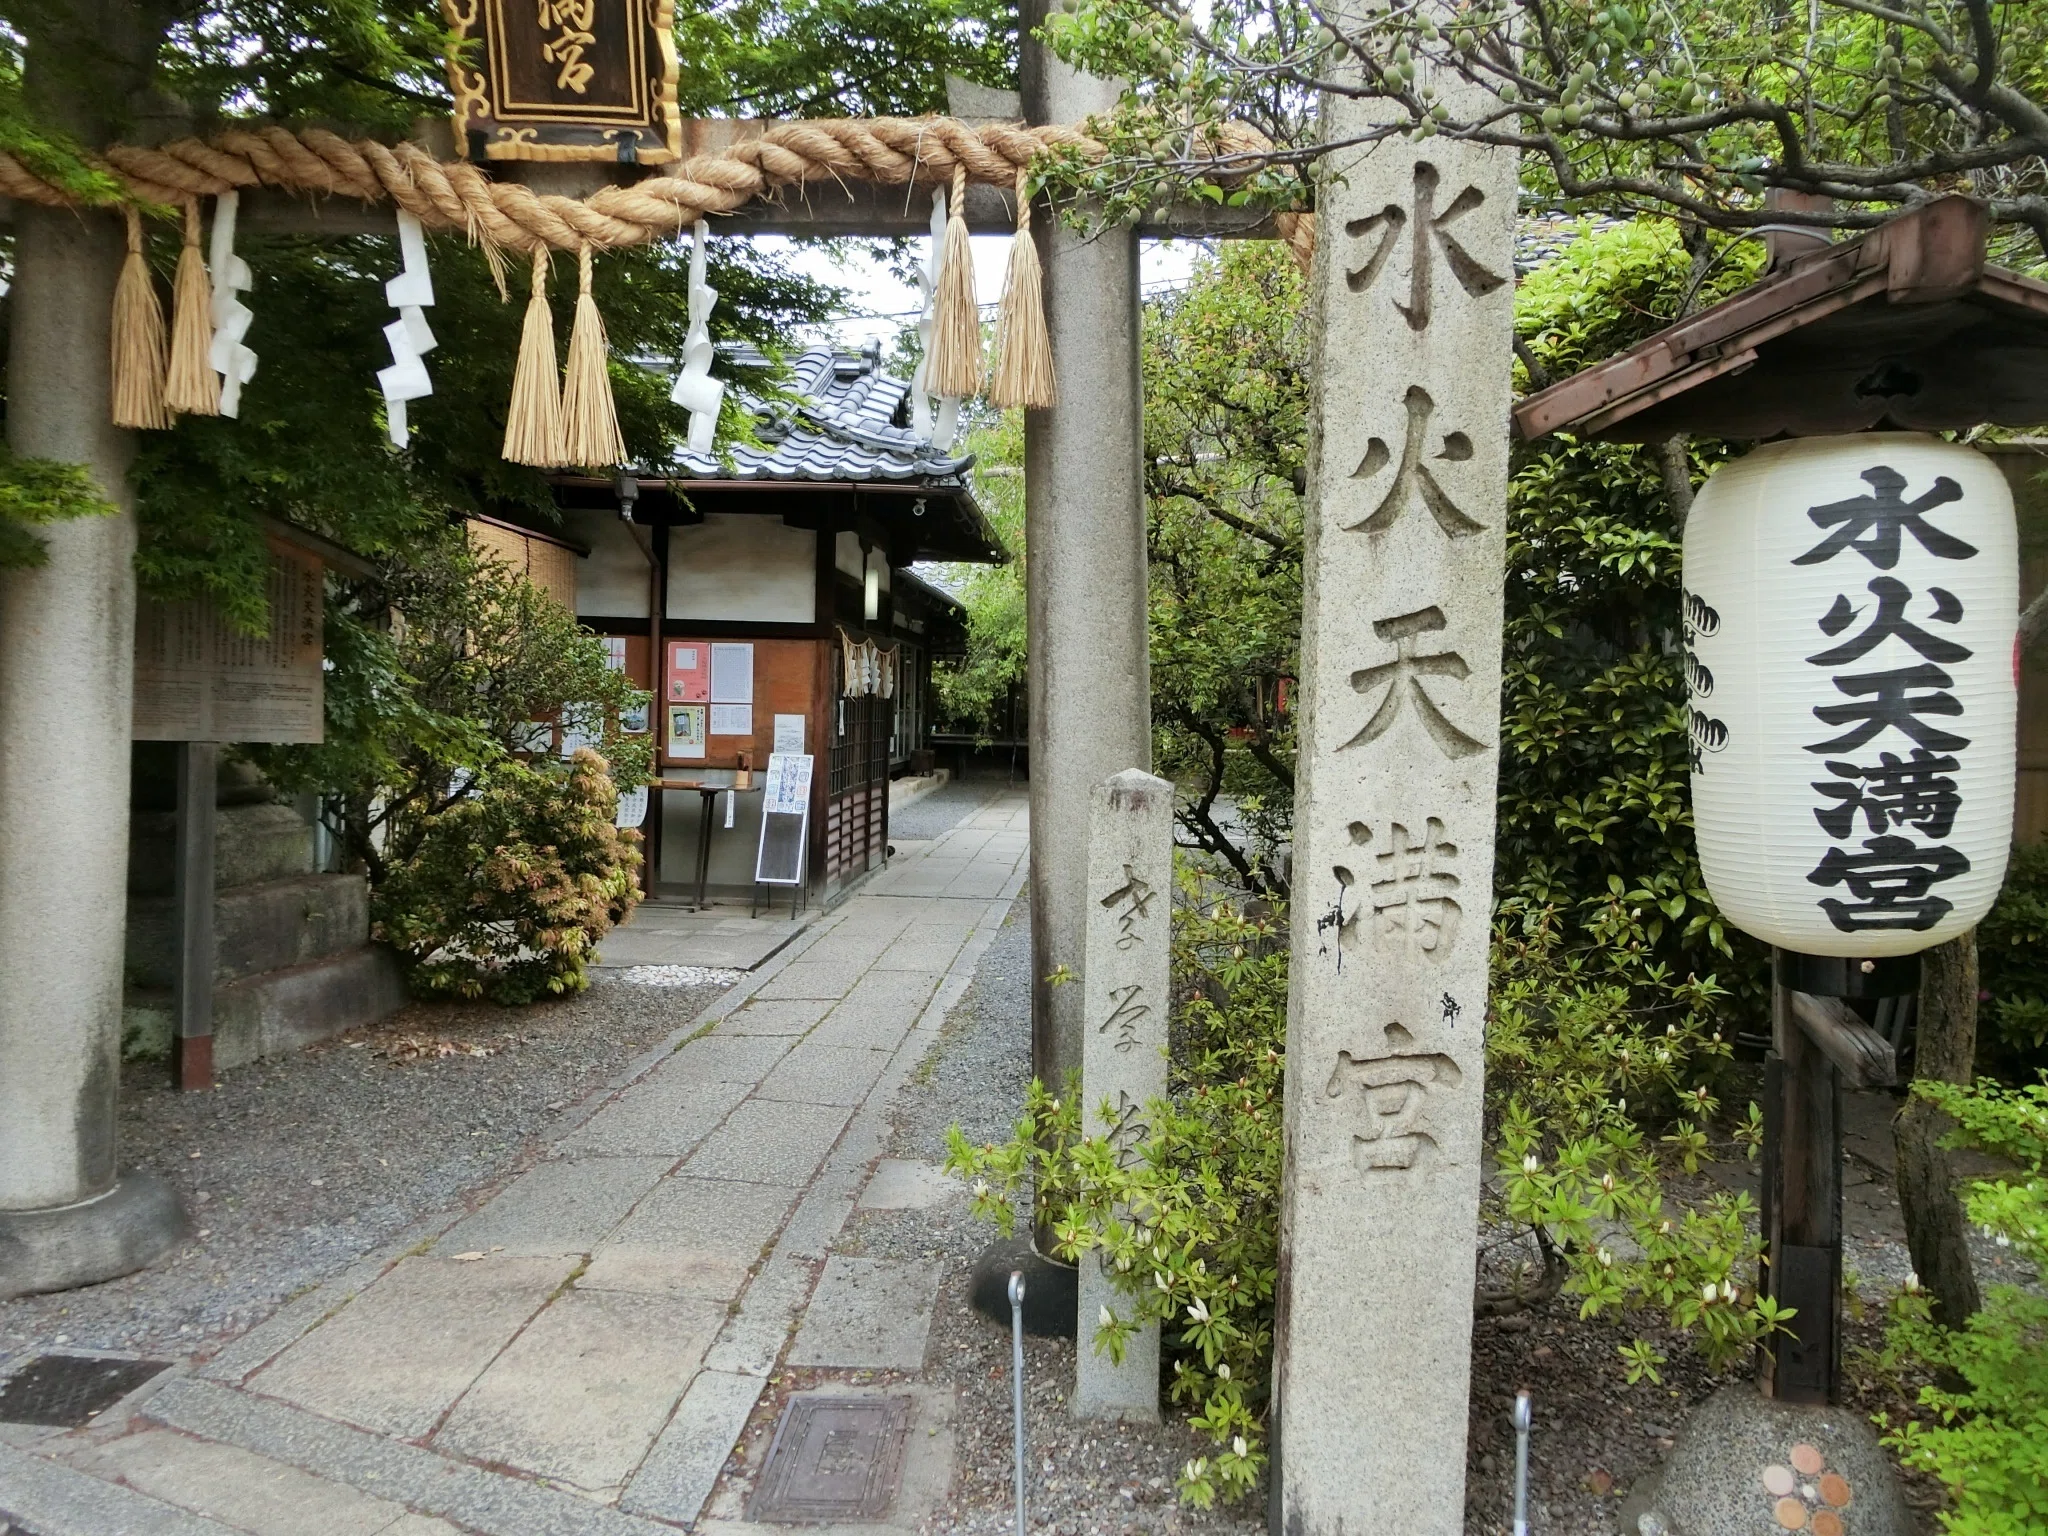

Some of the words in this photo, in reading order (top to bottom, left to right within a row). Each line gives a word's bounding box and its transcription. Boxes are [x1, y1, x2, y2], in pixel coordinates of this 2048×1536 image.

[1327, 160, 1507, 1174] 水火天満宮
[1790, 465, 1980, 932] 水火天満宮
